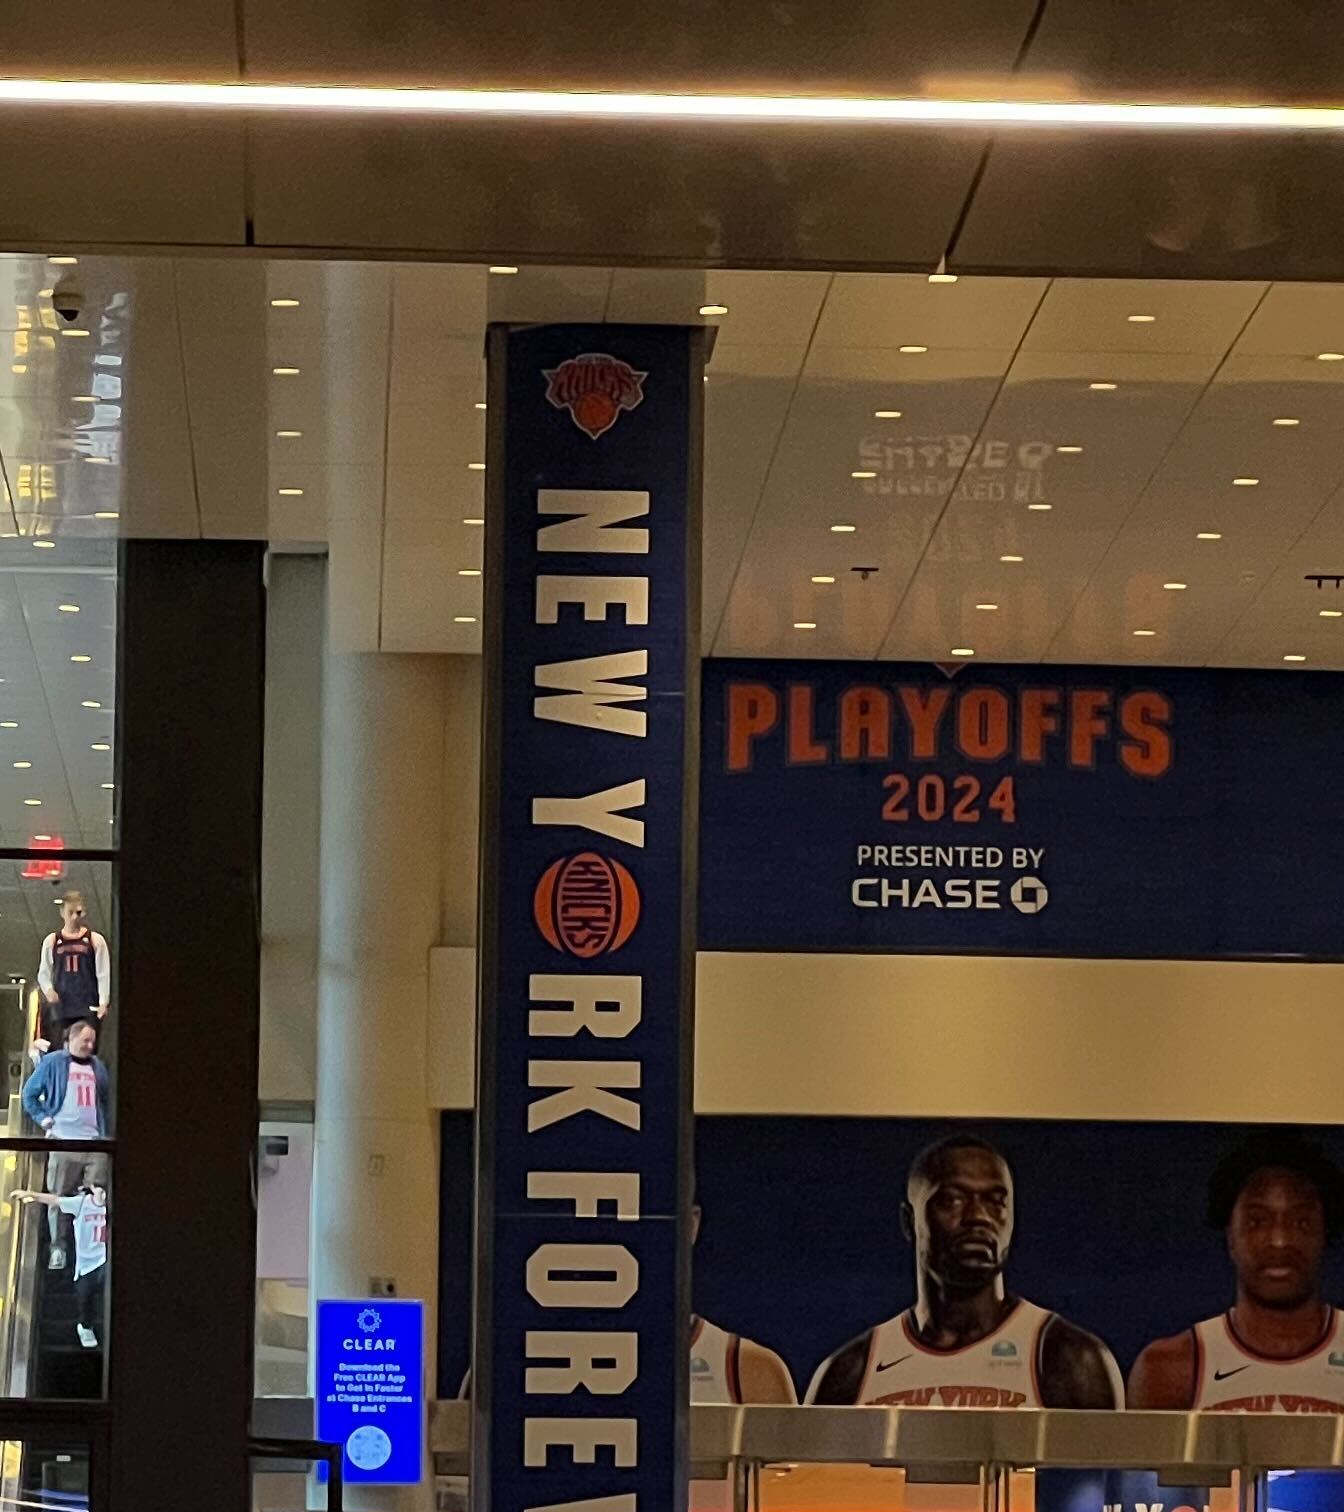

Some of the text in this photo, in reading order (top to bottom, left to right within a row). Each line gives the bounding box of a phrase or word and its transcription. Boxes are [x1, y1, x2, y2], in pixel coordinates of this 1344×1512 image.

[534, 489, 649, 737] NEW
[725, 684, 1174, 777] PLAYOFFS
[881, 773, 1016, 823] 2024
[857, 844, 1045, 869] PRESENTED BY
[851, 877, 1001, 908] CHASE
[342, 1338, 396, 1350] CLEAR
[355, 1373, 386, 1382] CLEAR
